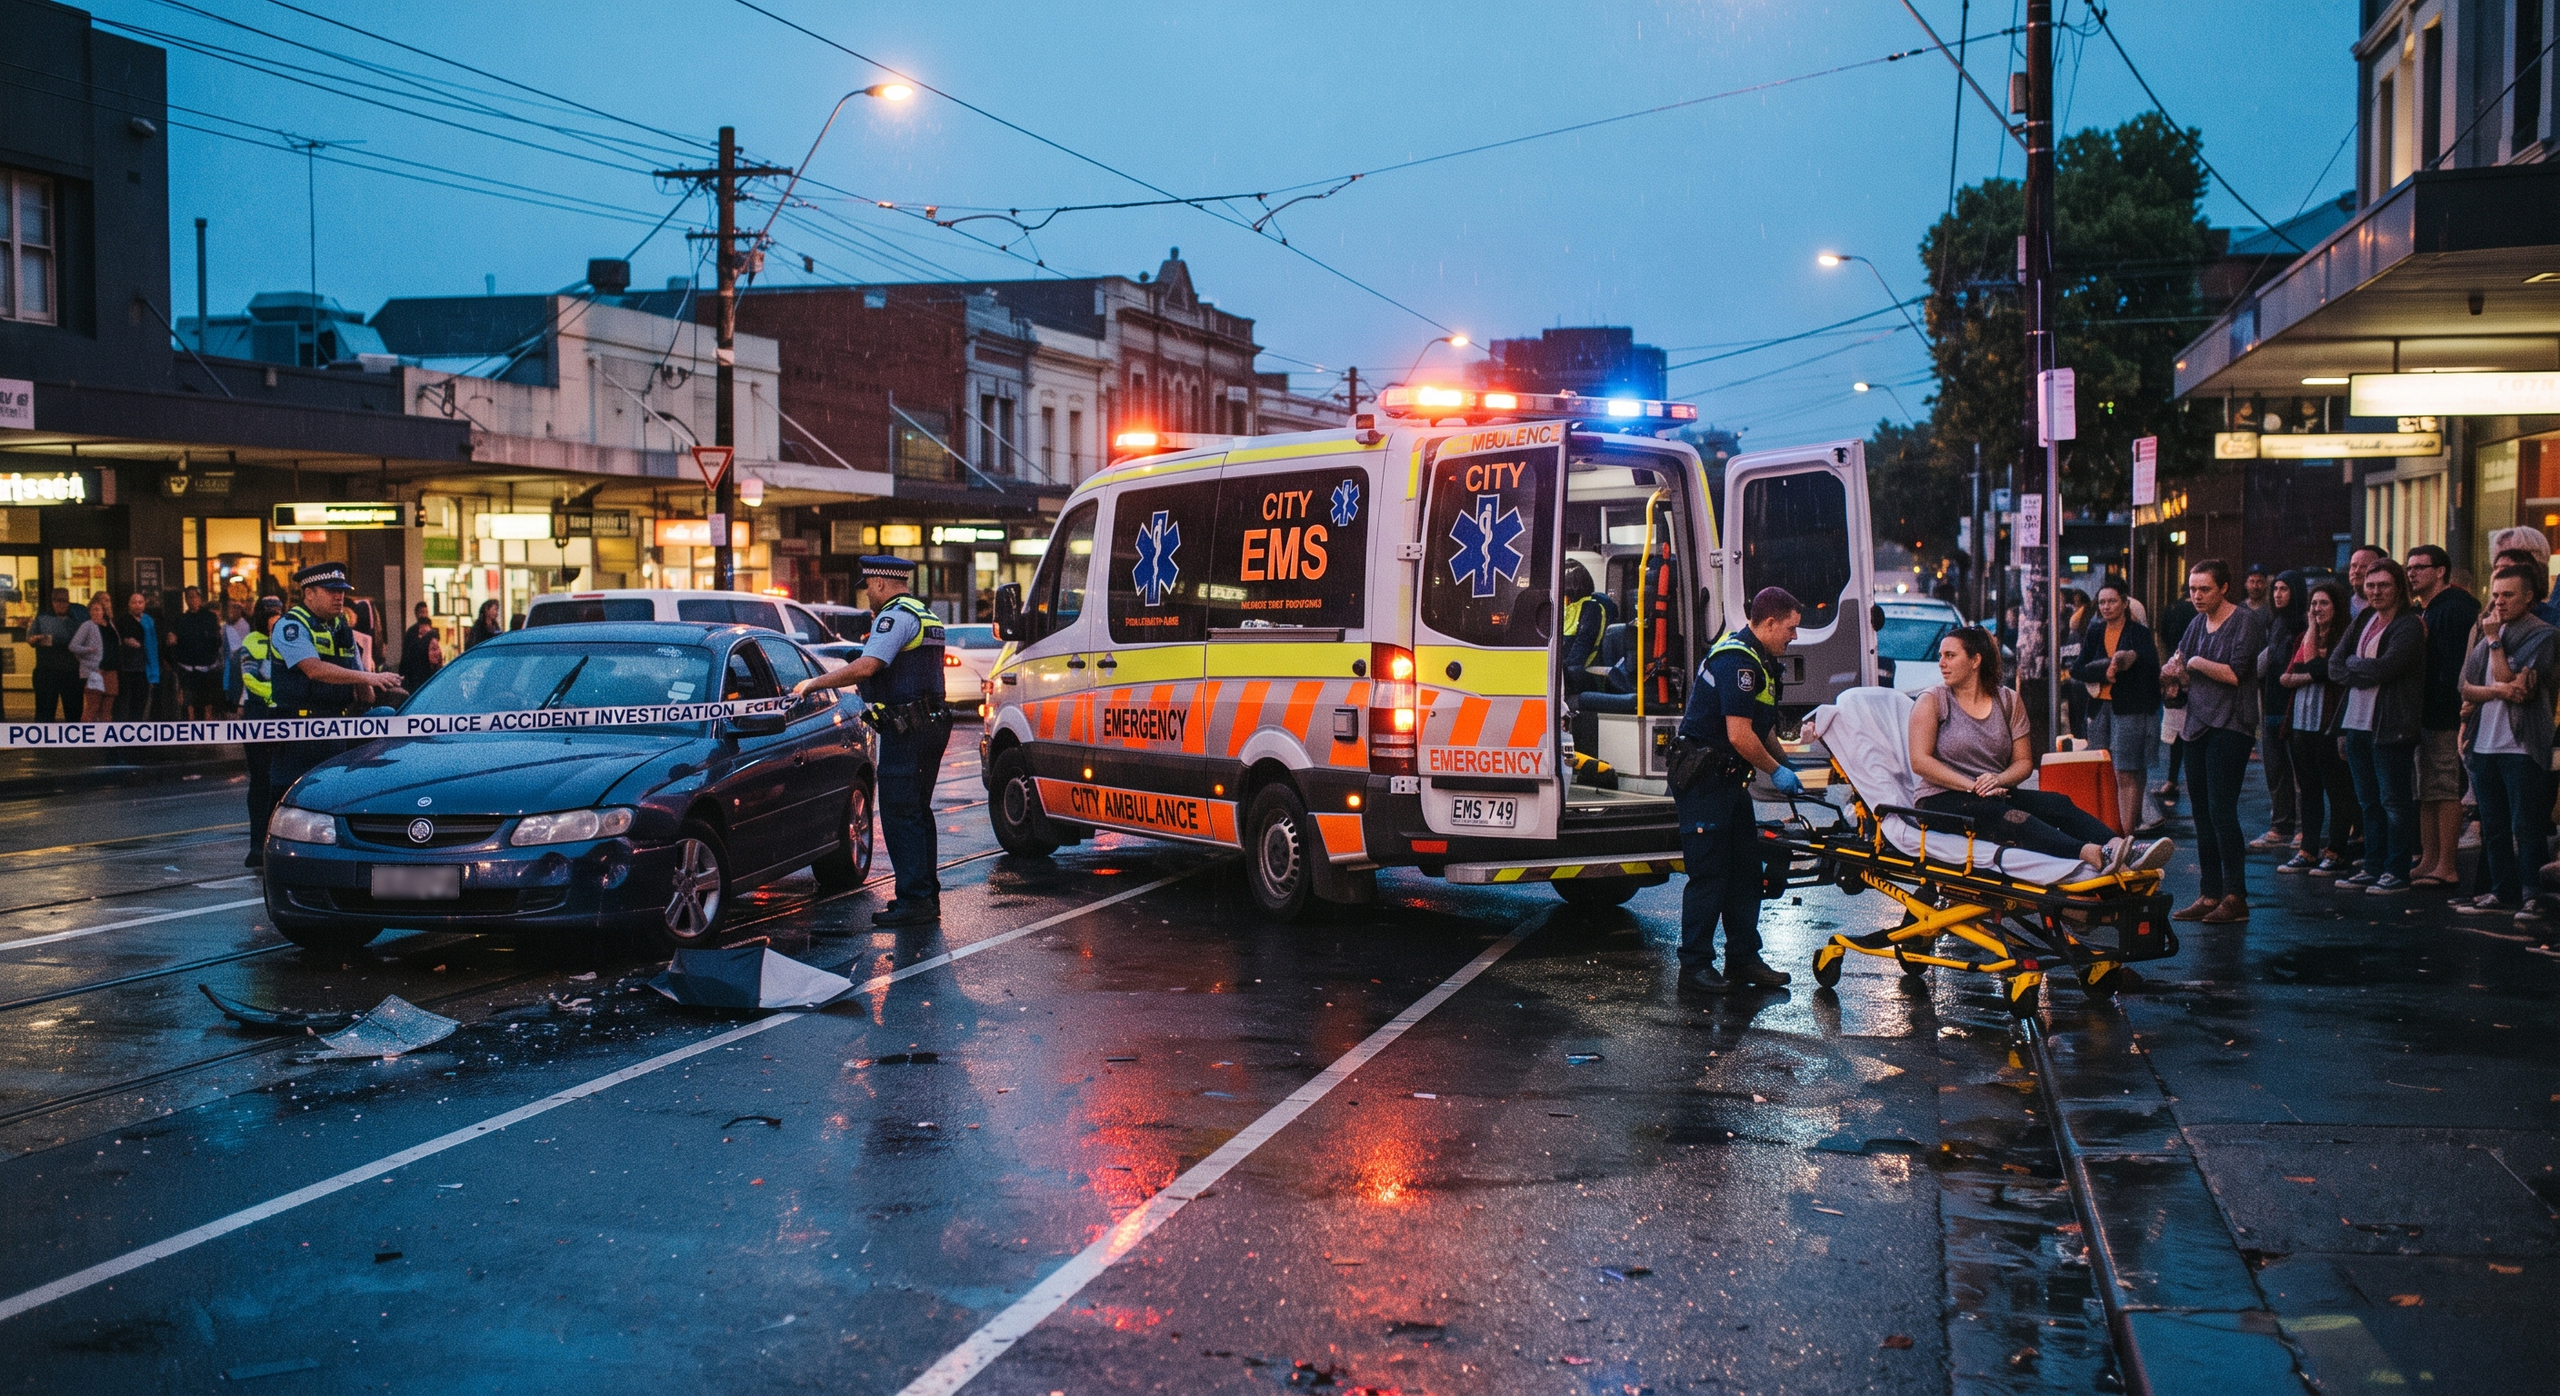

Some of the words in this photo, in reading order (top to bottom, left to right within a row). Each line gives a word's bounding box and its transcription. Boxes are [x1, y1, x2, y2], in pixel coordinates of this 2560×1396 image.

[1465, 461, 1526, 492] CITY
[1262, 489, 1313, 521] CITY
[1240, 524, 1328, 582] EMS
[9, 725, 96, 744] POLICE
[103, 723, 220, 743] ACCIDENT
[226, 718, 389, 741] INVESTIGATION
[407, 715, 482, 735] POLICE
[488, 711, 590, 731] ACCIDENT
[594, 703, 735, 725] INVESTIGATION
[1103, 708, 1188, 742] EMERGENCY
[1429, 749, 1543, 775] EMERGENCY
[1071, 786, 1100, 816] CITY
[1104, 791, 1199, 830] AMBULANCE
[1453, 799, 1482, 820] EMS
[1488, 801, 1514, 821] 749
